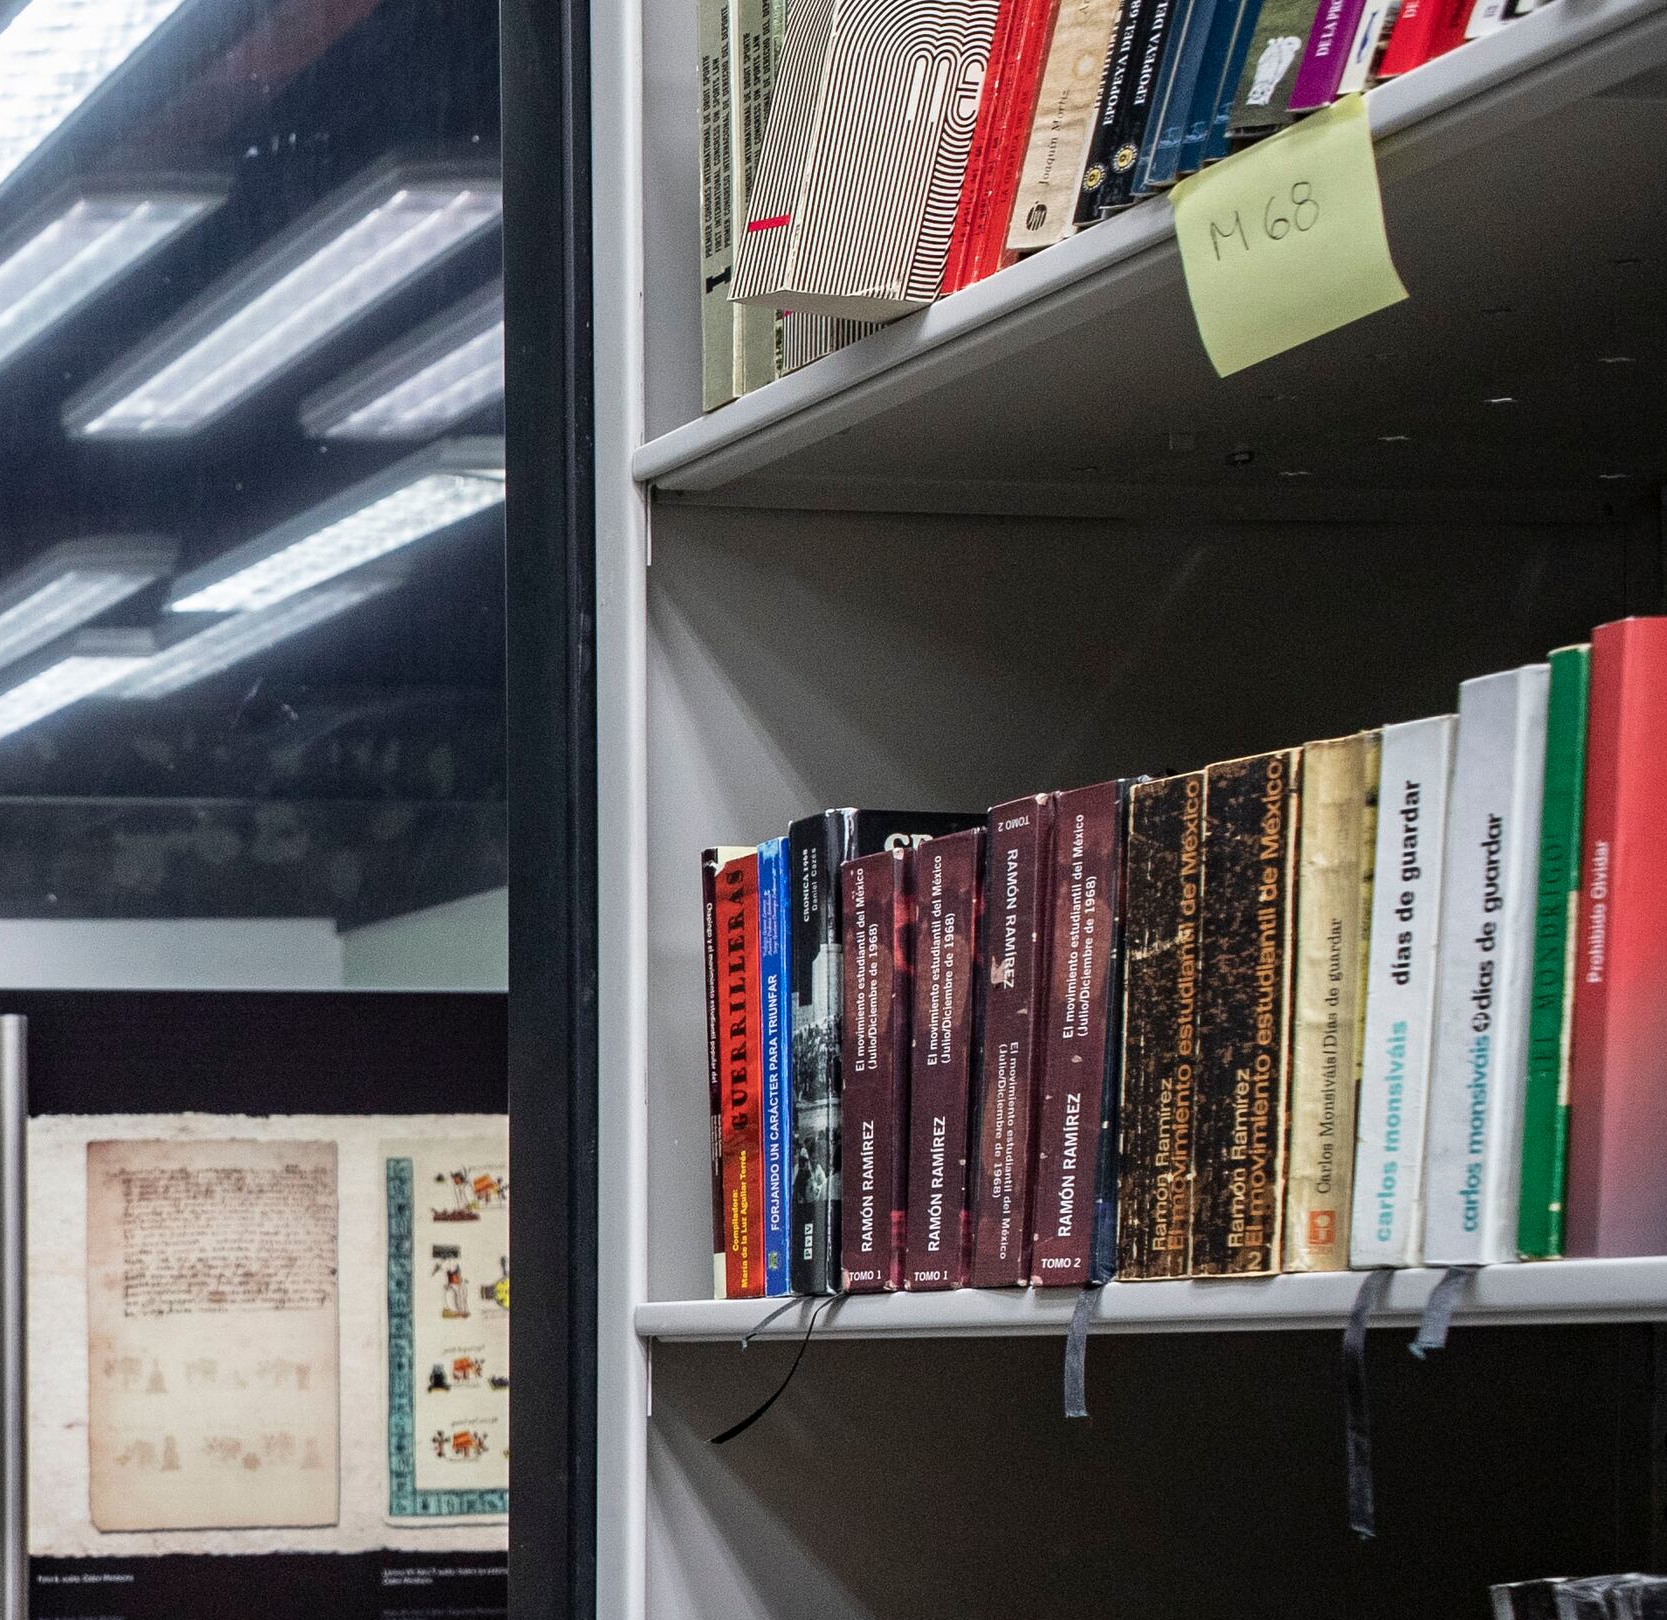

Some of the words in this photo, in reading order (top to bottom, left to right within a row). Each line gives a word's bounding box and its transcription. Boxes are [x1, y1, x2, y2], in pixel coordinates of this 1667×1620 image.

[702, 55, 710, 87] SPORTIF
[711, 57, 720, 76] LAW
[712, 77, 720, 109] SPORTS
[1134, 32, 1161, 105] EPOPEYA
[702, 88, 710, 111] DROIT
[703, 112, 711, 124] DE
[703, 125, 712, 185] INTERNATIONAL
[1038, 137, 1059, 186] Joaquín
[713, 167, 722, 229] INTERNATIONAL
[1209, 205, 1250, 262] M
[1264, 181, 1319, 240] 68
[704, 223, 714, 258] PREMIER
[1069, 814, 1085, 858] México
[1398, 781, 1422, 882] guardar
[851, 867, 865, 908] México
[930, 855, 943, 897] México
[1004, 849, 1021, 909] RAMÓN
[1071, 862, 1083, 881] del
[854, 910, 865, 928] del
[931, 899, 942, 918] del
[943, 912, 955, 947] 1968)
[1069, 883, 1081, 949] estudiantil
[1395, 891, 1416, 923] de
[854, 930, 866, 989] estudiantil
[867, 922, 879, 956] 1968)
[867, 962, 878, 976] de
[929, 920, 942, 980] estudiantil
[942, 953, 953, 967] de
[1003, 914, 1018, 990] RAMÍREZ
[1390, 931, 1414, 986] días
[726, 871, 750, 1132] GUERRILLERAS
[767, 975, 778, 1037] TRIUNFAR
[927, 981, 941, 1054] movimiento
[940, 968, 954, 1063] (Julio/Diciembre
[1062, 951, 1078, 1027] movimiento
[854, 990, 866, 1060] movimiento
[867, 977, 880, 1070] (Julio/Diciembre
[1009, 1041, 1020, 1051] El
[1062, 1029, 1073, 1039] El
[768, 1037, 778, 1071] PARA
[855, 1062, 866, 1072] El
[927, 1055, 939, 1065] El
[766, 1073, 780, 1142] CARÁCTER
[1006, 1054, 1019, 1126] movimiento
[1230, 1068, 1251, 1161] Ramírez
[1382, 1021, 1408, 1153] monsiváis
[769, 1144, 779, 1162] UN
[928, 1117, 946, 1189] RAMÍREZ
[1060, 1093, 1081, 1170] RAMÍREZ
[1154, 1078, 1174, 1168] Ramírez
[858, 1120, 874, 1191] RAMÍREZ
[1003, 1129, 1016, 1192] estudiantil
[731, 1190, 740, 1252] Compiladora:
[769, 1164, 780, 1232] FORJANDO
[857, 1194, 874, 1252] RAMÓN
[926, 1193, 944, 1251] RAMÓN
[1002, 1195, 1013, 1213] del
[1056, 1175, 1076, 1237] RAMÓN
[1152, 1174, 1171, 1253] Ramón
[1227, 1168, 1246, 1248] Ramón
[1374, 1161, 1398, 1242] carlos
[999, 1218, 1013, 1259] México
